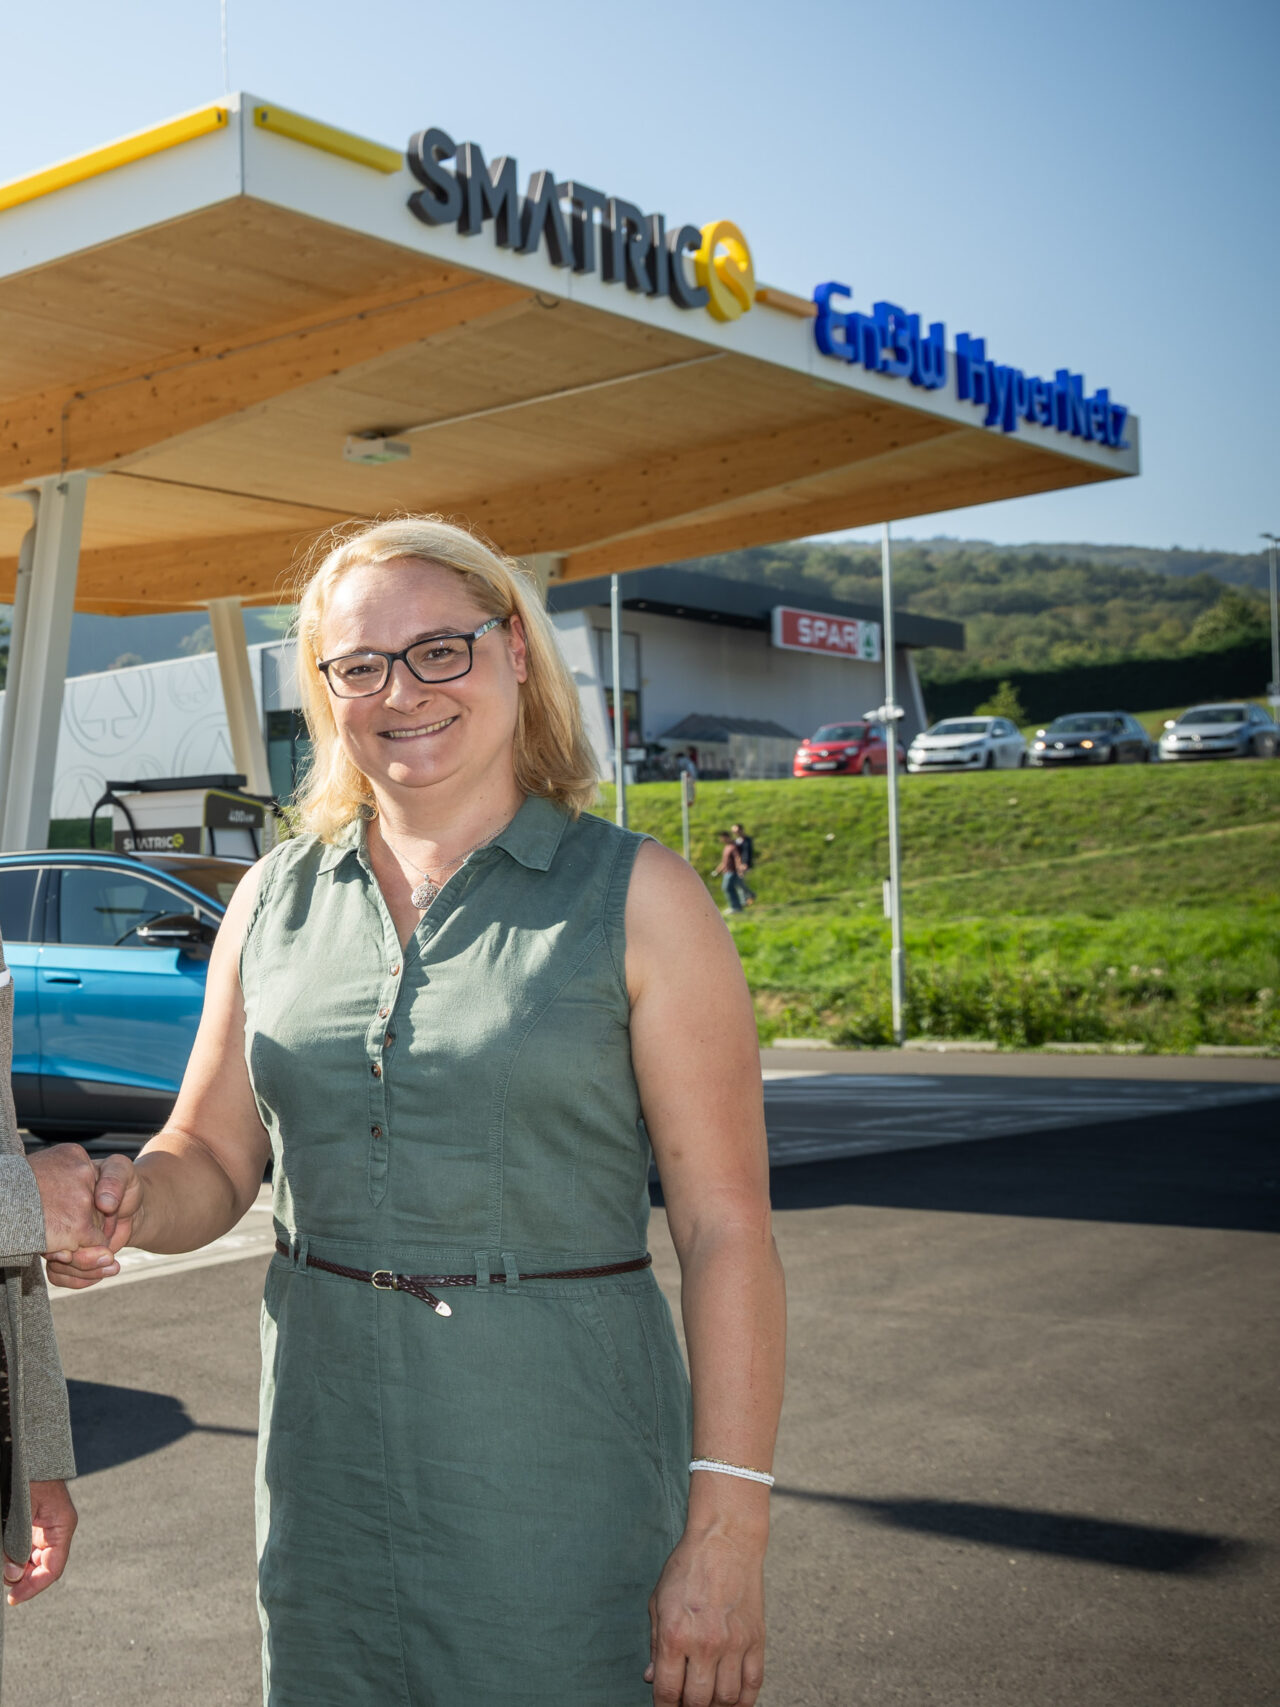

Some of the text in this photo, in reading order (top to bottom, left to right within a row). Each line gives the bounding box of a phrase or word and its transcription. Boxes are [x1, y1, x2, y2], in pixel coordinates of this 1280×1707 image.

[814, 282, 1131, 450] EnBW HyperNetz
[797, 617, 857, 651] SPAR
